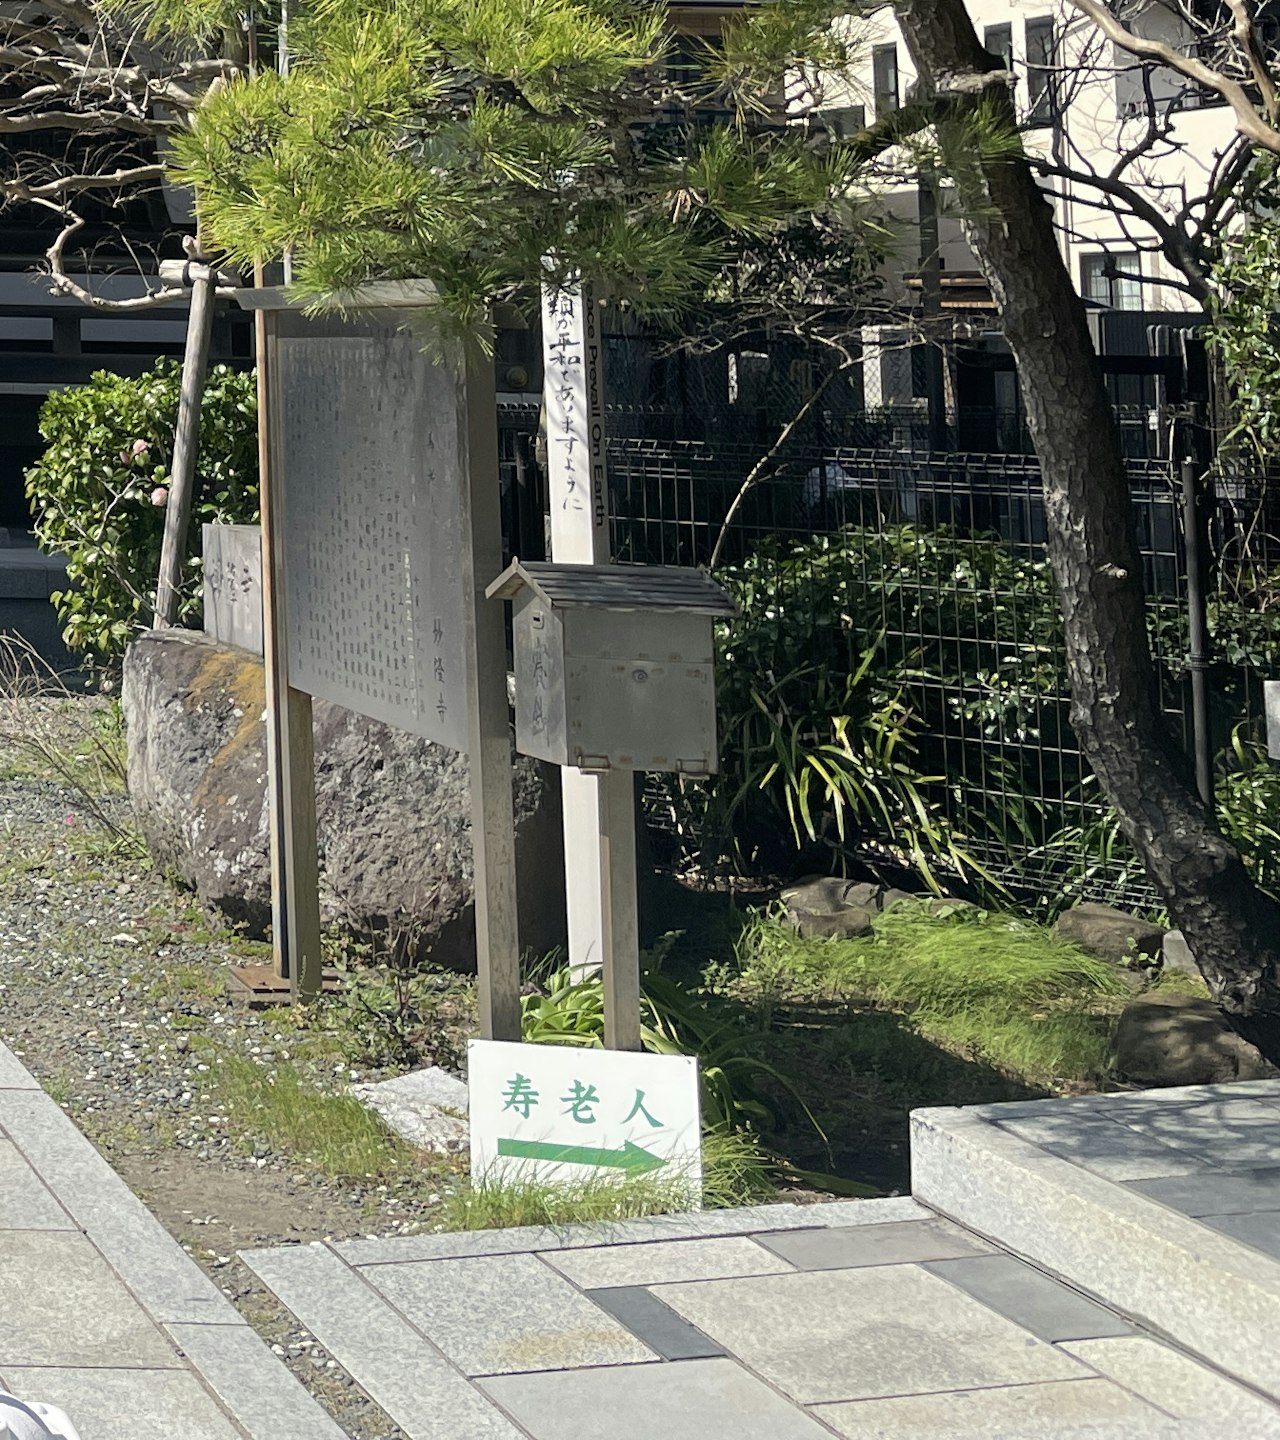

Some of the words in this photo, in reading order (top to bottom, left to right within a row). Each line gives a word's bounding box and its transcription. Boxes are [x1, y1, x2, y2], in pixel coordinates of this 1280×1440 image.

[586, 279, 597, 340] eace
[588, 345, 601, 418] Prevail
[592, 424, 602, 457] On
[594, 464, 605, 527] Earth
[500, 1071, 665, 1128] 寿老人
